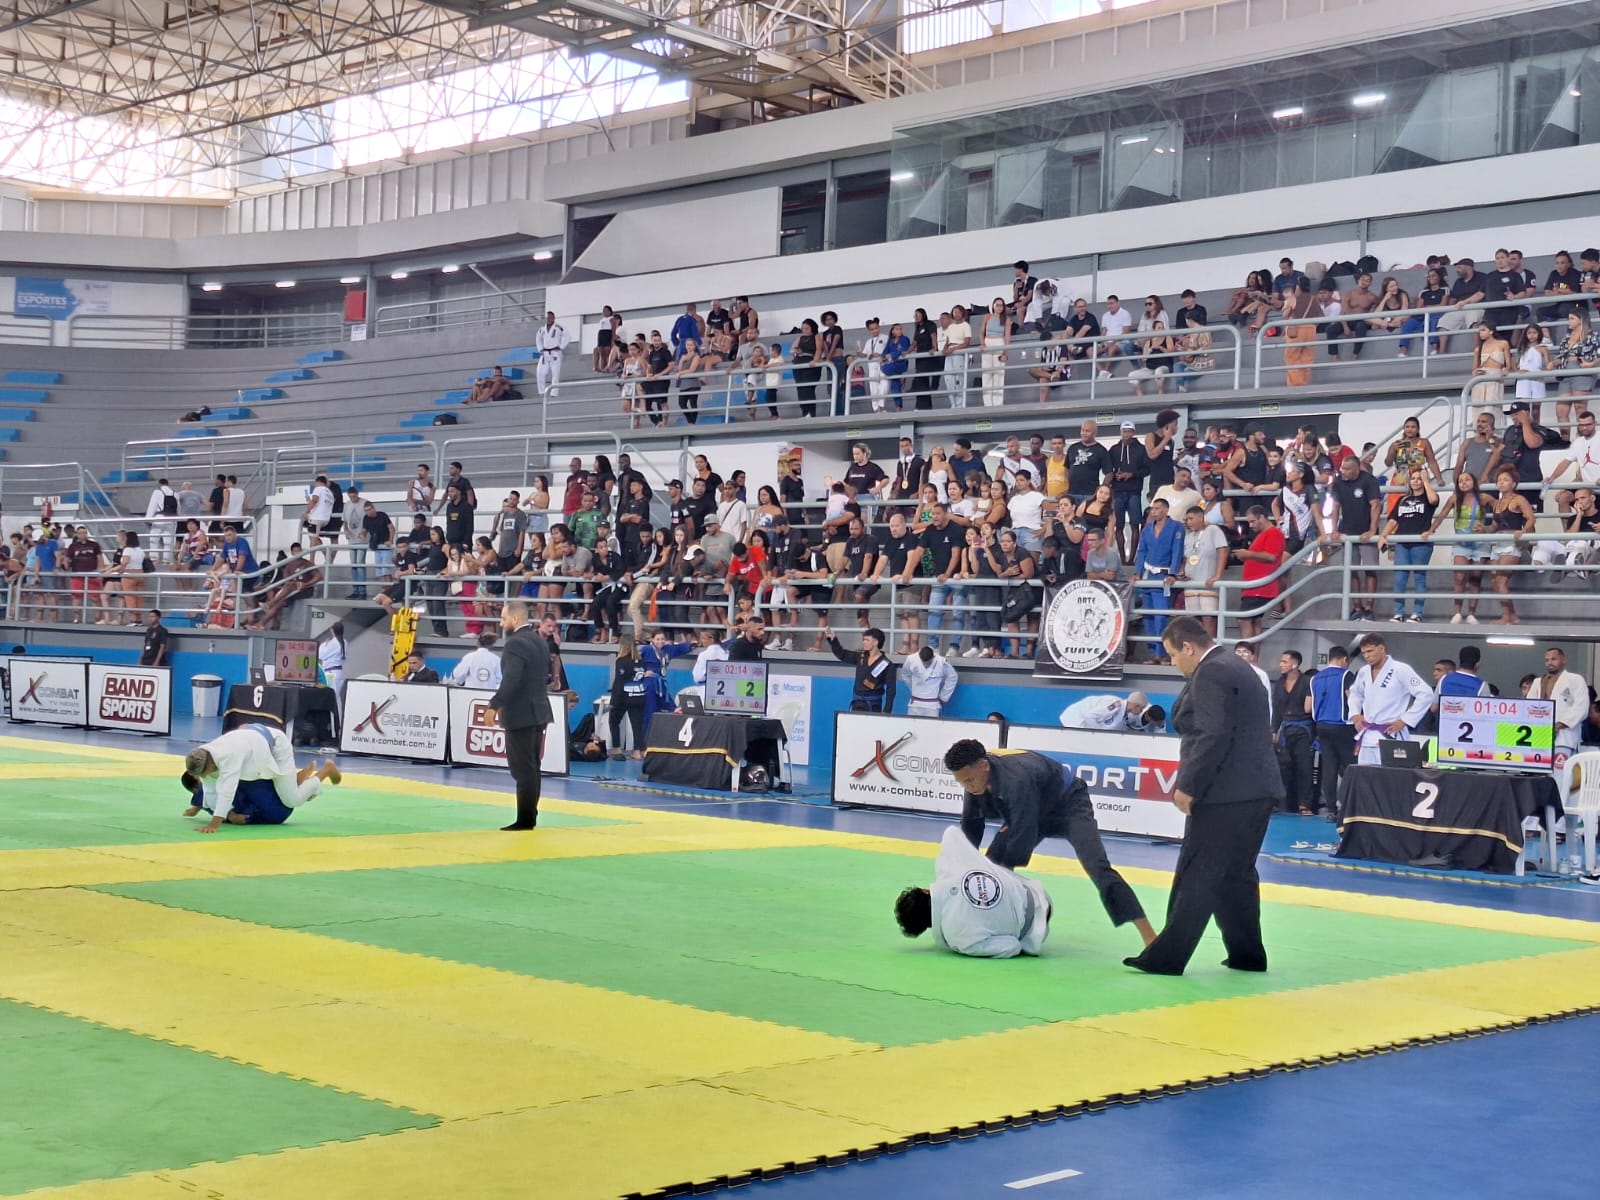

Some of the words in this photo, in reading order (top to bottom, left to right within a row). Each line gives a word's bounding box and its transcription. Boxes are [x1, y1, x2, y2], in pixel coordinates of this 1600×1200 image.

[17, 295, 67, 305] ESPORTES
[1077, 597, 1096, 605] ARTE
[1064, 647, 1100, 655] SUAVE
[282, 655, 289, 669] 0
[303, 656, 310, 670] 0
[725, 664, 747, 675] 02:14
[105, 677, 155, 698] BAND
[717, 680, 725, 696] 2
[746, 681, 755, 697] 2
[253, 685, 264, 708] 6
[102, 698, 153, 720] SPORTS
[1474, 701, 1518, 715] 01:04
[410, 731, 438, 739] NEWS
[678, 717, 695, 747] 4
[1457, 721, 1474, 743] 2
[1515, 725, 1533, 747] 2
[351, 735, 437, 749] www.x-combat.com.br
[470, 729, 506, 753] SPO
[1448, 747, 1455, 757] 0
[1505, 751, 1512, 761] 2
[1534, 753, 1542, 763] 0
[916, 777, 934, 785] TV
[938, 778, 959, 788] NE
[849, 783, 964, 801] www.x-combat.com
[1412, 781, 1439, 819] 2
